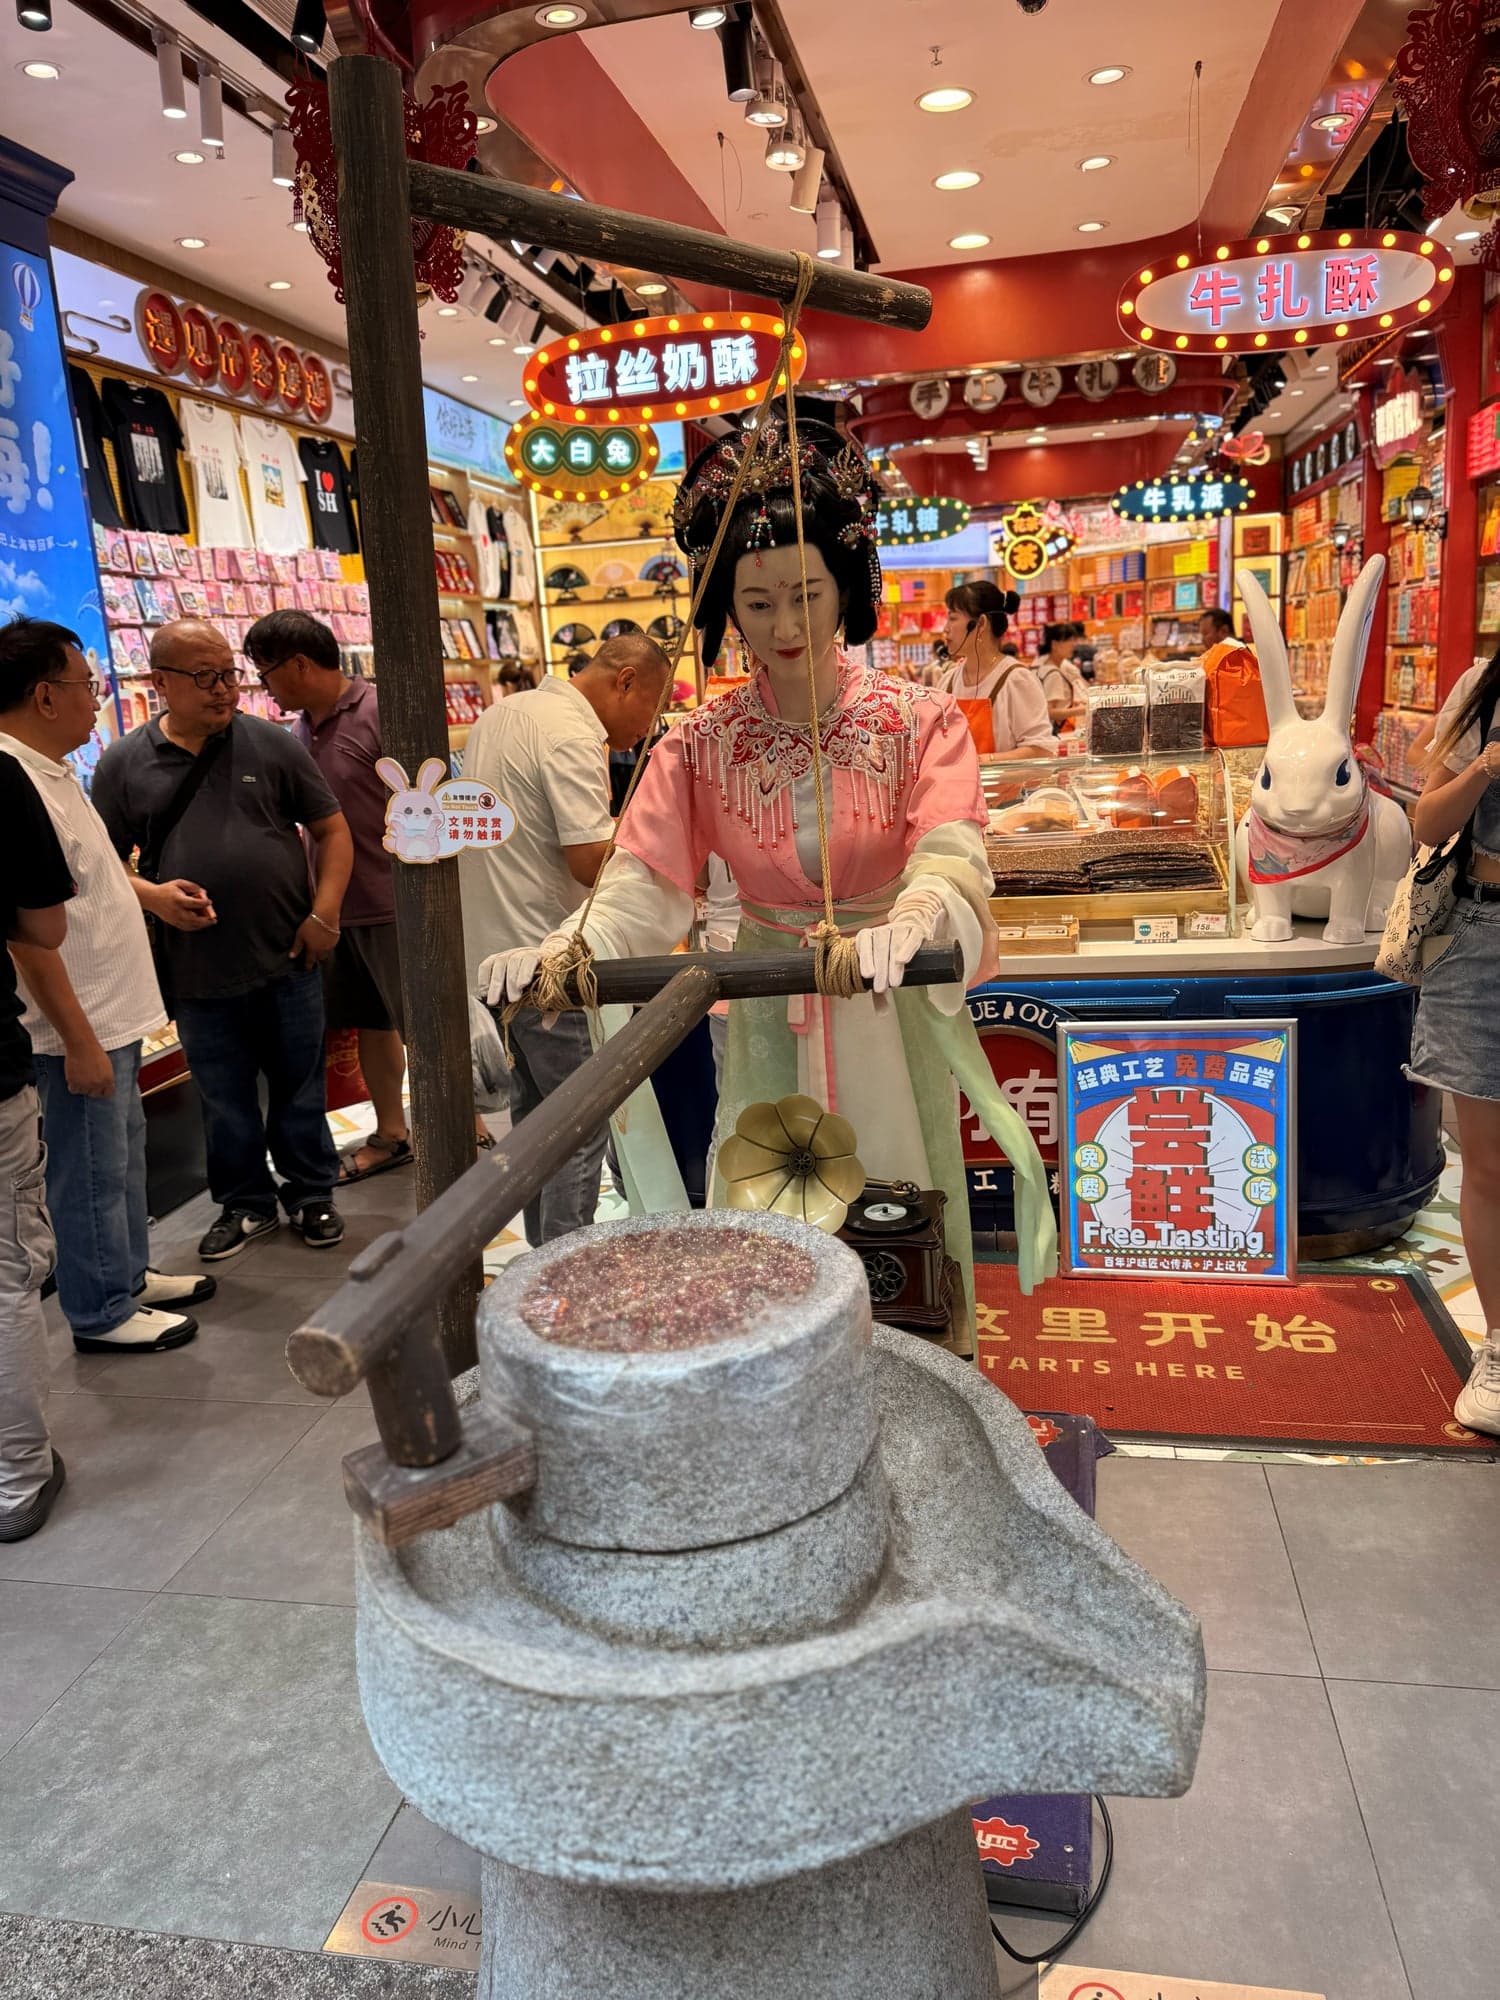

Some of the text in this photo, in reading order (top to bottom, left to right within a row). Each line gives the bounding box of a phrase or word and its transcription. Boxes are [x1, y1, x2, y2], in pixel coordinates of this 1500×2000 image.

[1189, 254, 1379, 327] 牛扎酥
[565, 334, 759, 404] 拉丝奶酥
[531, 437, 632, 466] 大白兔
[317, 491, 339, 513] SH
[1142, 482, 1224, 513] 牛乳派
[448, 816, 502, 828] 文明观赏
[448, 829, 502, 841] 请勿触摸
[1076, 1053, 1275, 1091] 经典工艺 免费品尝
[1079, 1148, 1102, 1199] 免费
[1249, 1150, 1271, 1200] 试吃
[1083, 1221, 1264, 1254] Free Tasting
[1202, 1259, 1248, 1272] 沪上记忆
[1135, 1361, 1245, 1380] HERE
[433, 1937, 468, 1950] Mind
